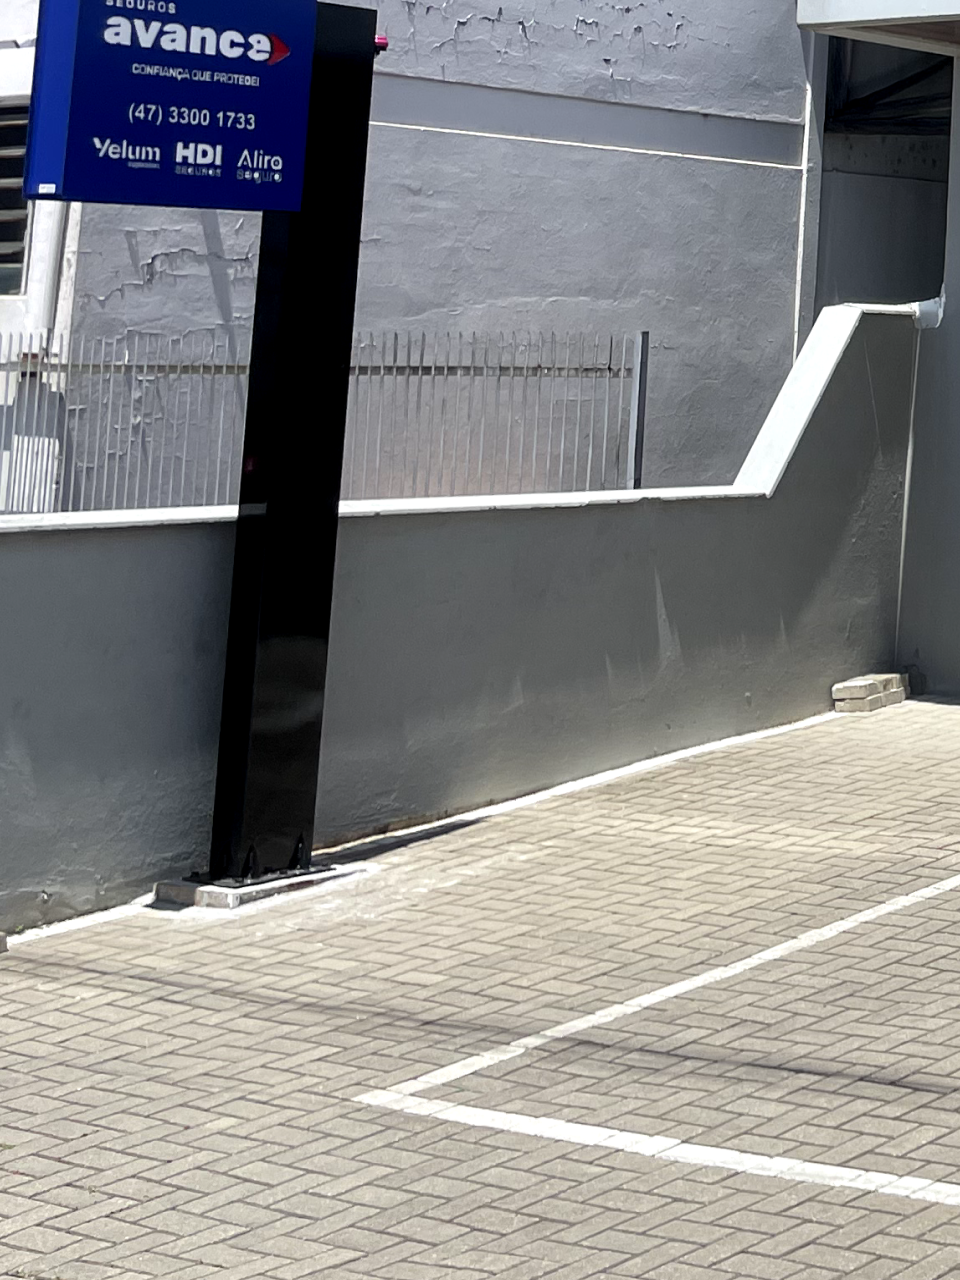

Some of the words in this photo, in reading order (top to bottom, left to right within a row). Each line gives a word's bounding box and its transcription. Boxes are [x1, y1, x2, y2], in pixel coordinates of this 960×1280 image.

[103, 15, 272, 62] avance
[132, 63, 190, 80] CONFIANÇA
[192, 70, 212, 82] QUE
[129, 102, 163, 126] (47)
[168, 106, 210, 126] 3300
[217, 110, 256, 130] 1733
[93, 136, 161, 162] Yelum
[175, 141, 222, 166] HDI
[237, 148, 283, 171] Aliro
